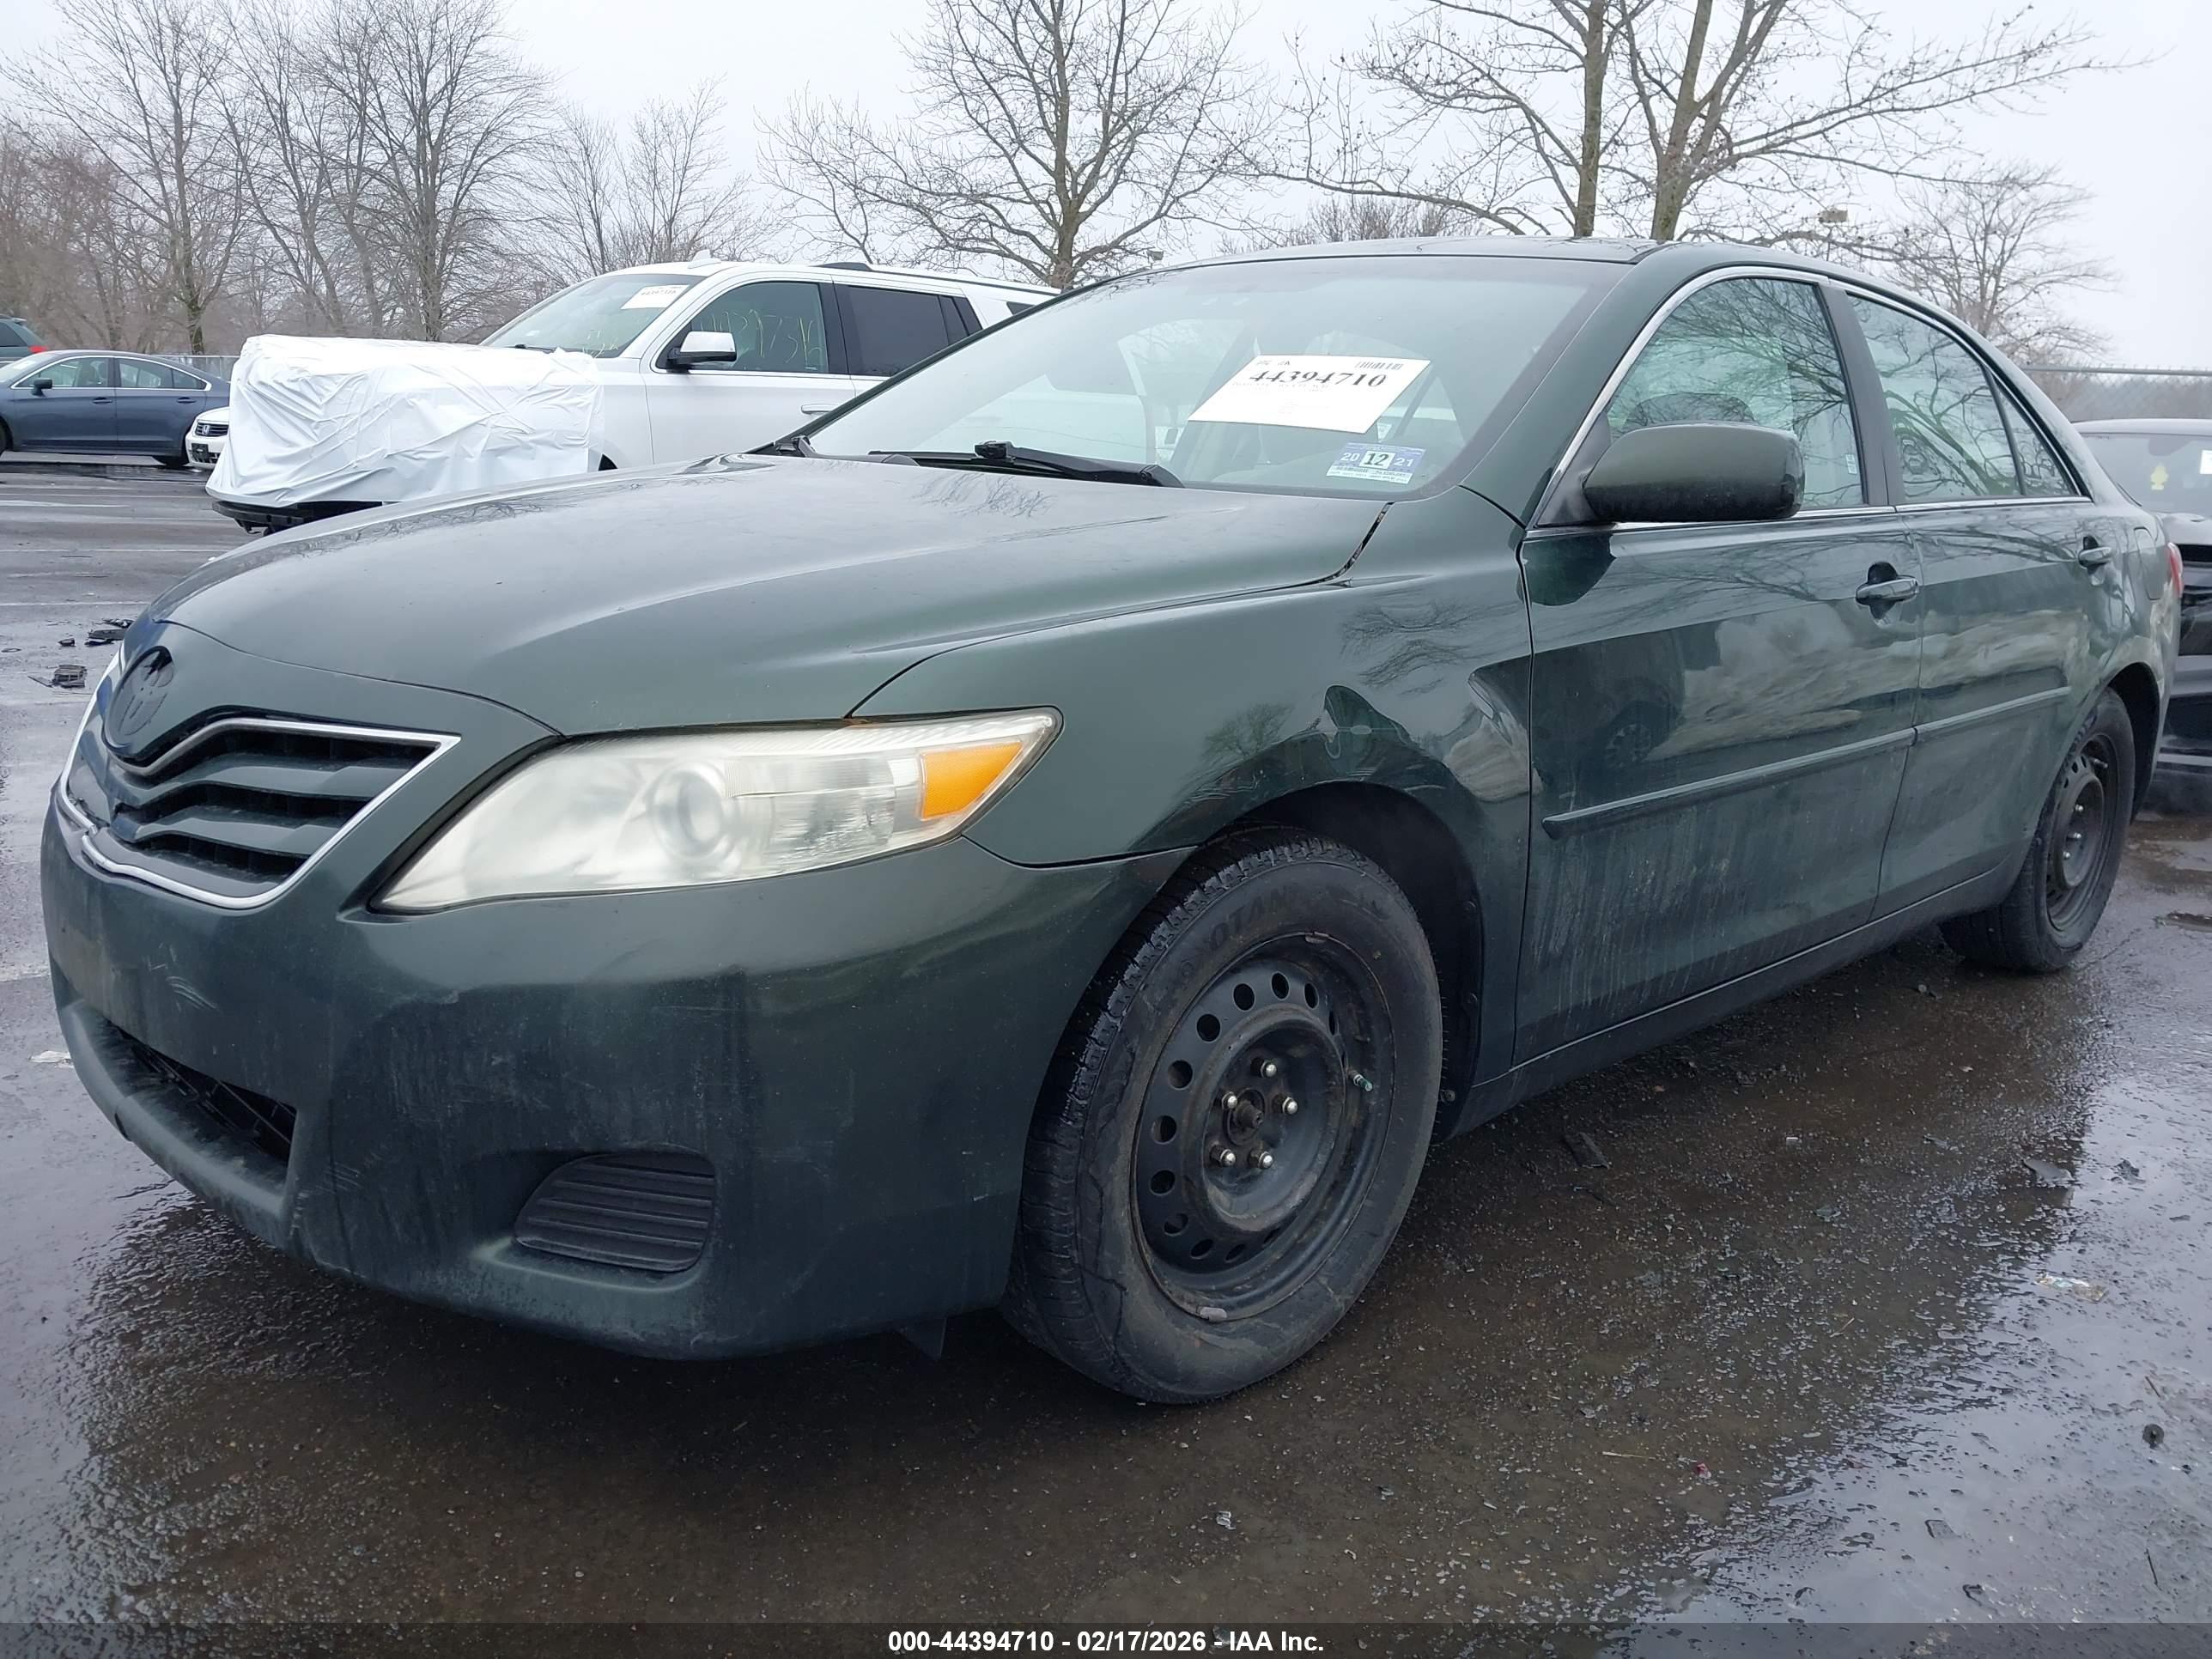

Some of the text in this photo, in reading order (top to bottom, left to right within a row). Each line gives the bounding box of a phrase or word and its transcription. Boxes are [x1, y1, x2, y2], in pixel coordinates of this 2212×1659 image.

[1249, 370, 1388, 387] 44394710
[1340, 452, 1415, 467] 20 12 21
